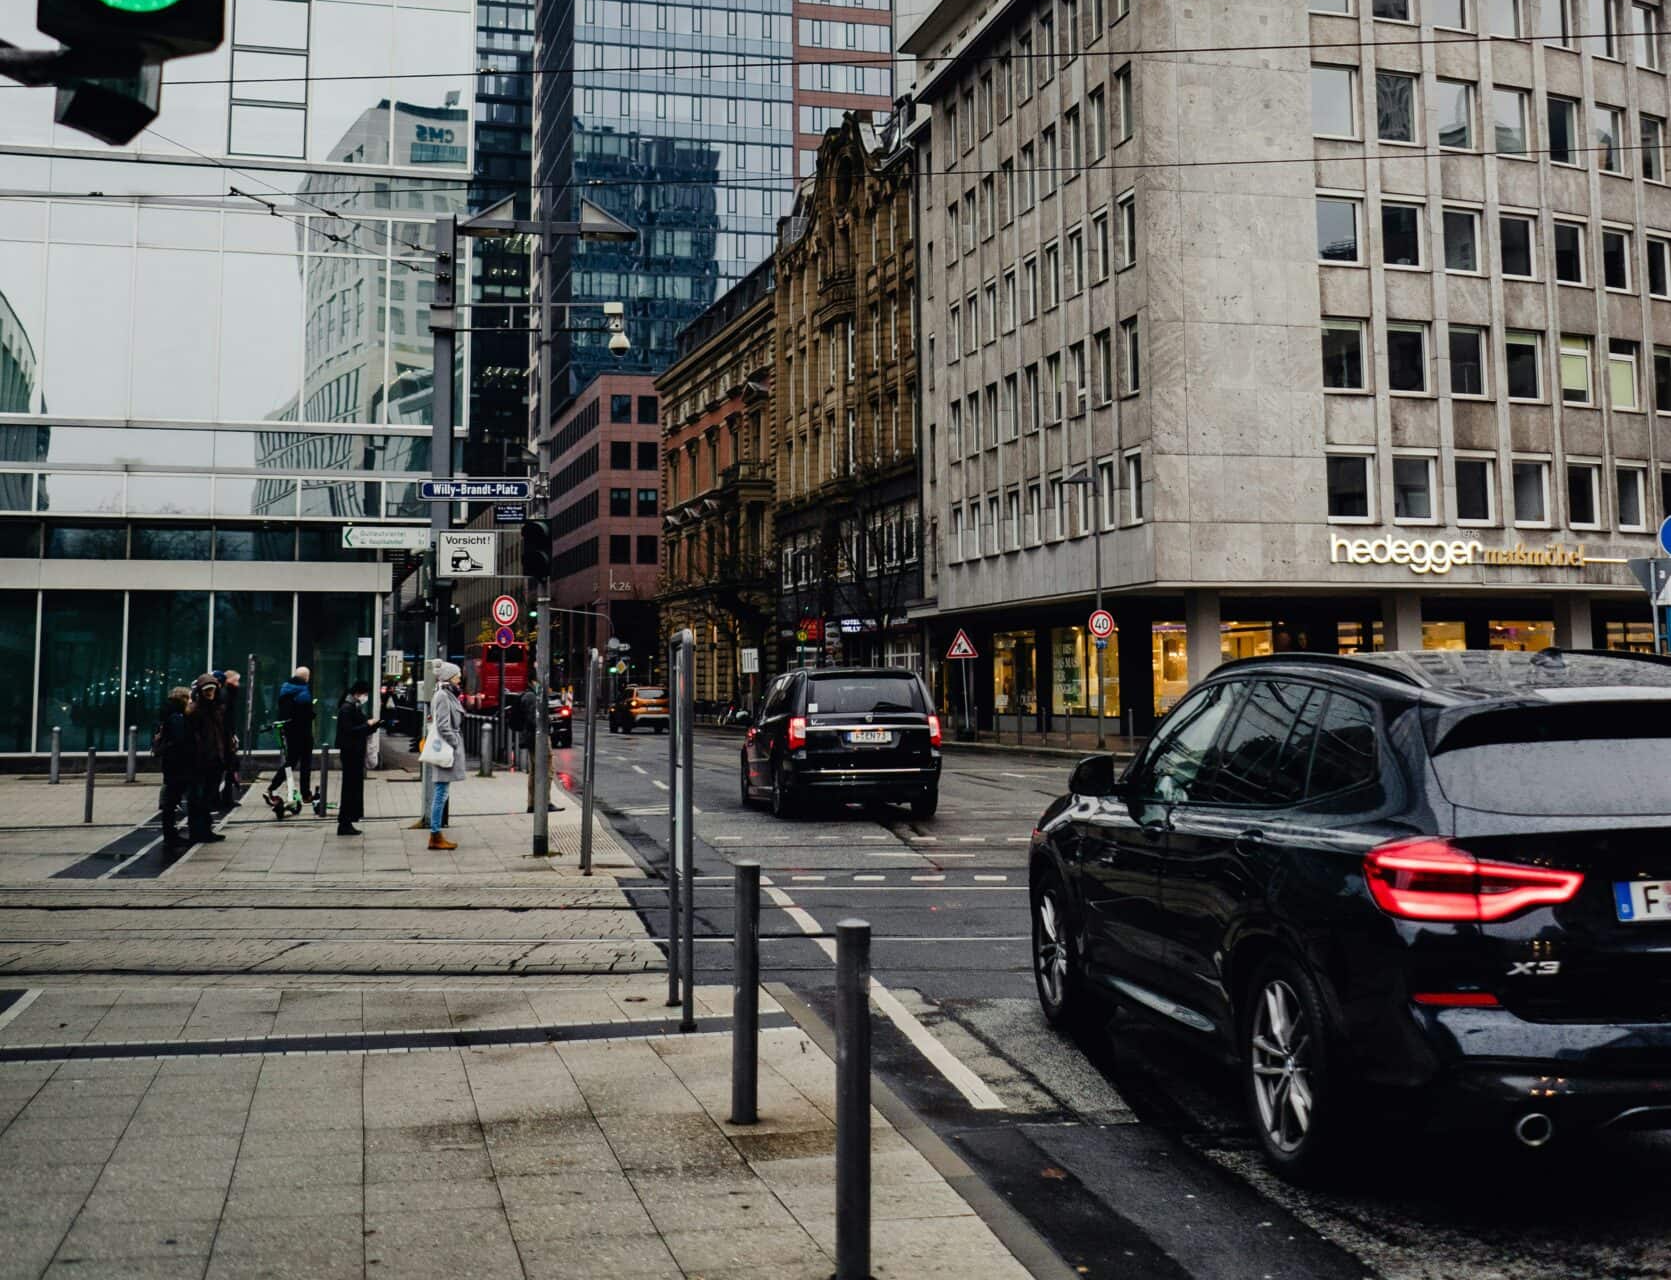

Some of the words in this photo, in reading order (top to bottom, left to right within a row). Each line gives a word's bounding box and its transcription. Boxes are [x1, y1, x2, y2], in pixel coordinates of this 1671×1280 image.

[433, 483, 518, 497] Willy-Brandt-Platz
[445, 535, 490, 544] Vorsicht!
[1330, 533, 1482, 573] hedegger
[499, 604, 513, 616] 40
[1095, 618, 1109, 630] 40
[1643, 885, 1660, 914] F
[1506, 961, 1561, 975] X3
